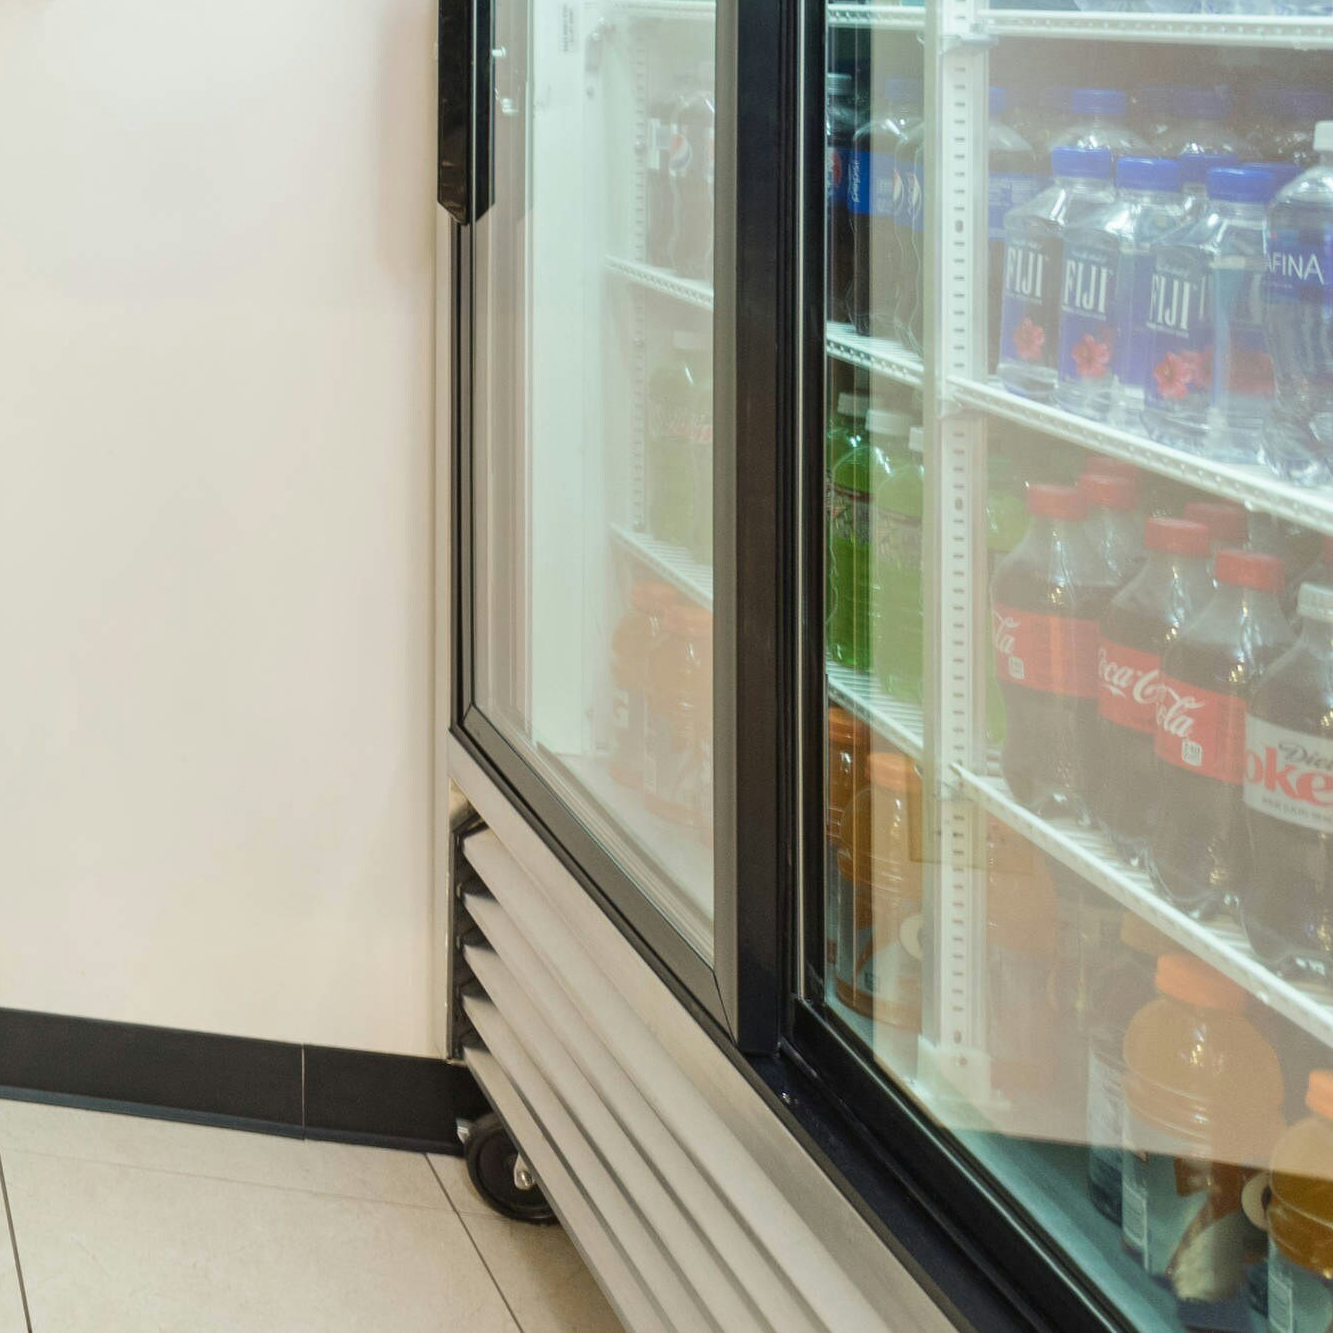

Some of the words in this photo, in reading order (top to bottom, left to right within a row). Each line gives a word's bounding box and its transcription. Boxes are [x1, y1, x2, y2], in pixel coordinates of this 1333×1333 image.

[1005, 246, 1044, 298] FIJI
[1064, 259, 1109, 314] FIJI
[1148, 272, 1192, 331] FIJI
